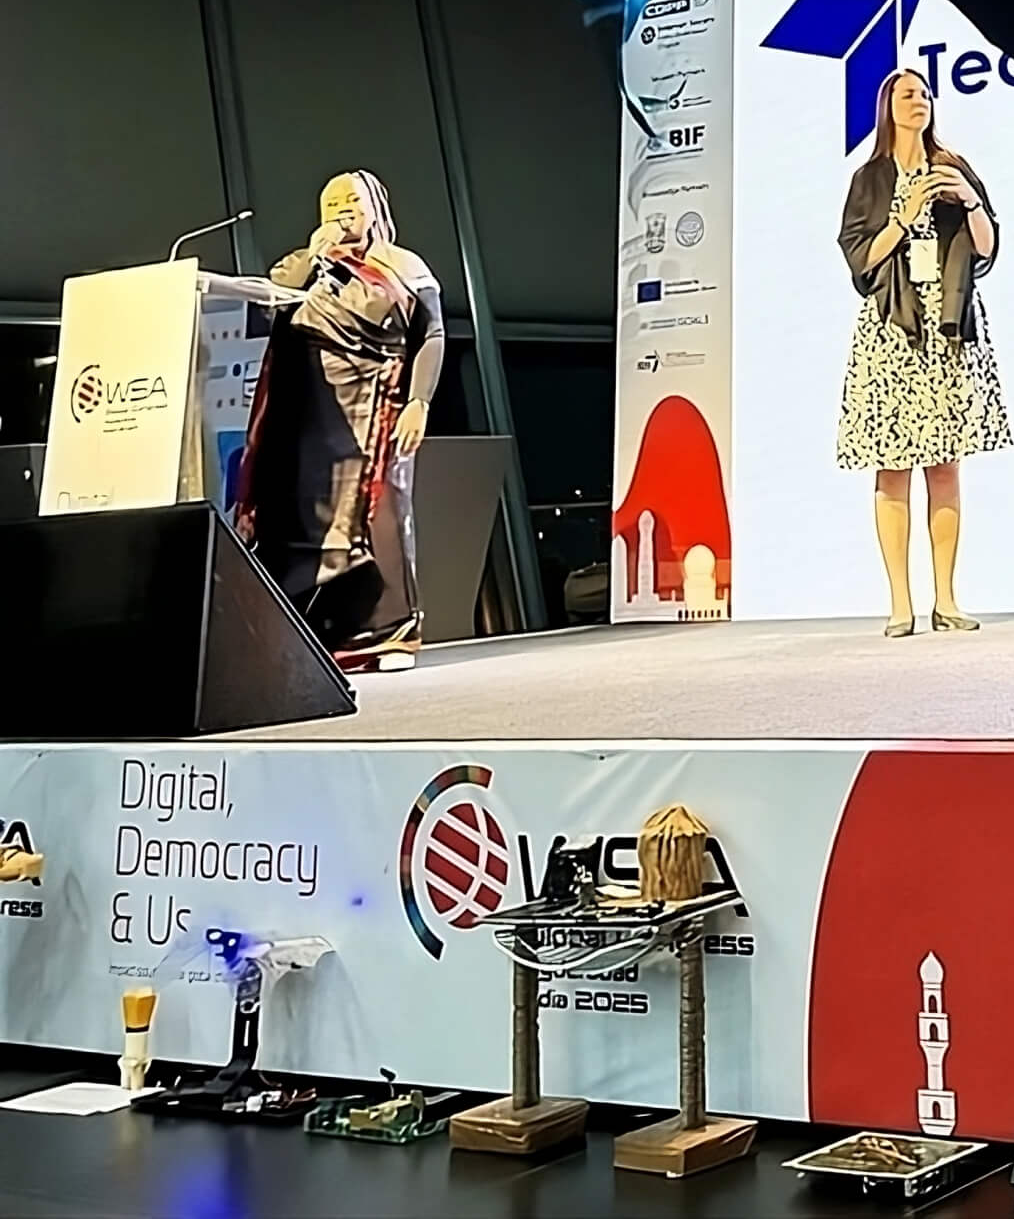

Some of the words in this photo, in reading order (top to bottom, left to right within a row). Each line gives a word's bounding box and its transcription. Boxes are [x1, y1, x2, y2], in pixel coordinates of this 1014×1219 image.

[106, 376, 167, 404] WSA
[121, 760, 233, 822] Digital,
[116, 826, 318, 896] Democracy
[111, 892, 132, 944] &
[575, 990, 649, 1014] 2025
